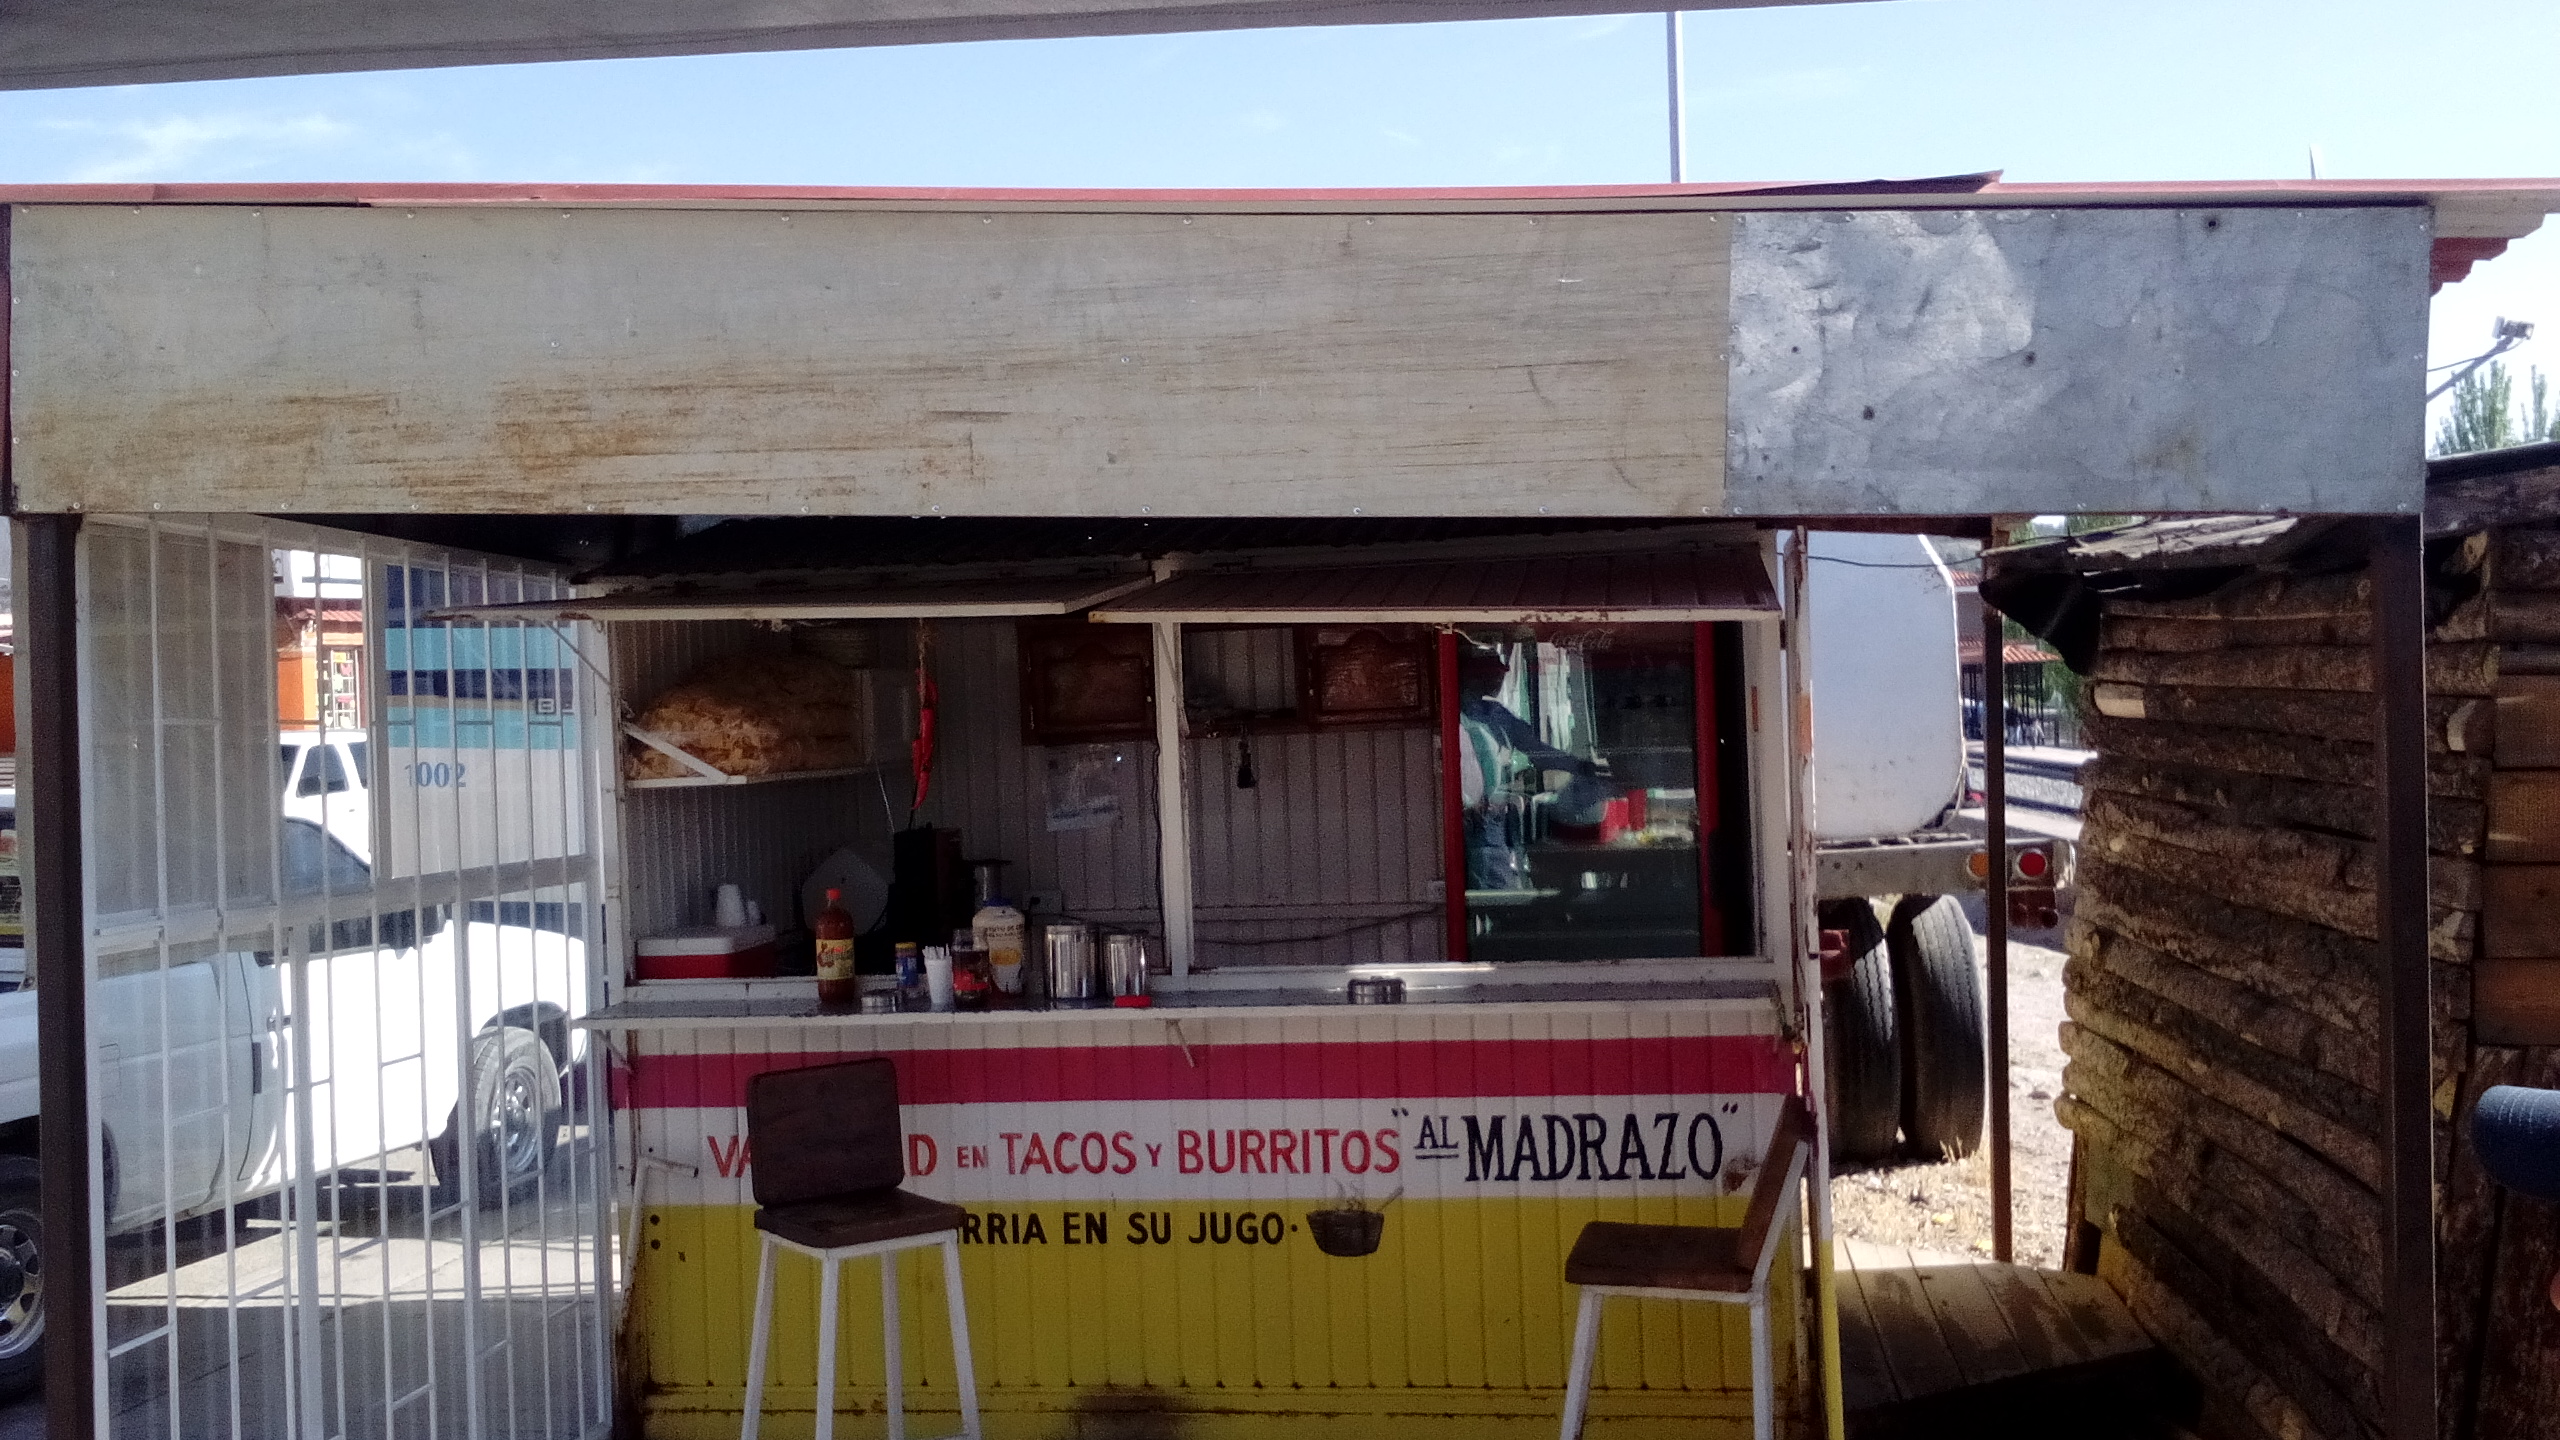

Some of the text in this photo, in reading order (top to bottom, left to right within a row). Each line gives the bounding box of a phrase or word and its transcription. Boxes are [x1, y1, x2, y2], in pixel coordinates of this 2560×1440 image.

[404, 762, 467, 787] 1002
[957, 1145, 988, 1168] EN
[1000, 1131, 1136, 1175] TACOS
[1145, 1142, 1163, 1167] Y
[1178, 1129, 1400, 1174] BURRITOS
[956, 1213, 1048, 1245] RRIA
[1063, 1212, 1108, 1244] EN
[1127, 1211, 1172, 1245] SU
